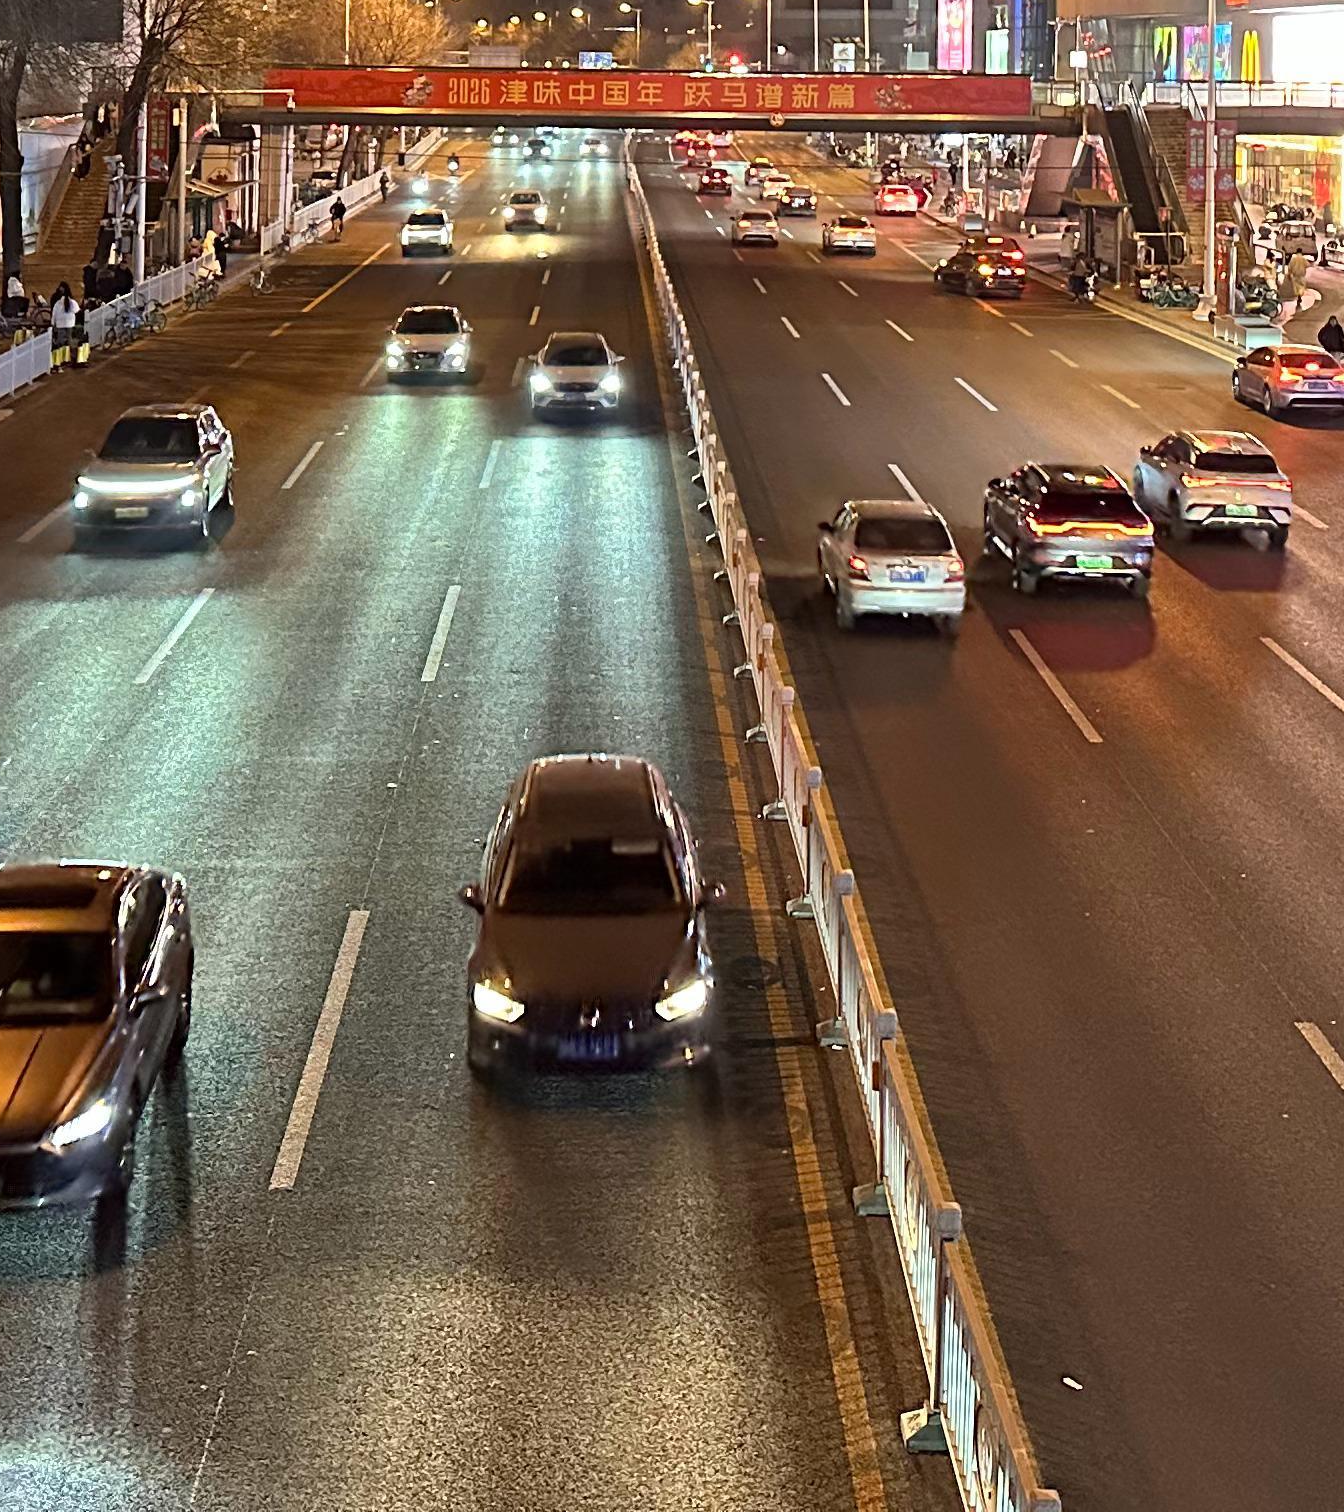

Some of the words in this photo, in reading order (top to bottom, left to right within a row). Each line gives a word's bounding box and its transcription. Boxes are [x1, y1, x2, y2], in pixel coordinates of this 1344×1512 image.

[448, 77, 491, 105] 2026
[499, 78, 665, 106] 津味中国年
[683, 82, 856, 109] 跃马谱新篇
